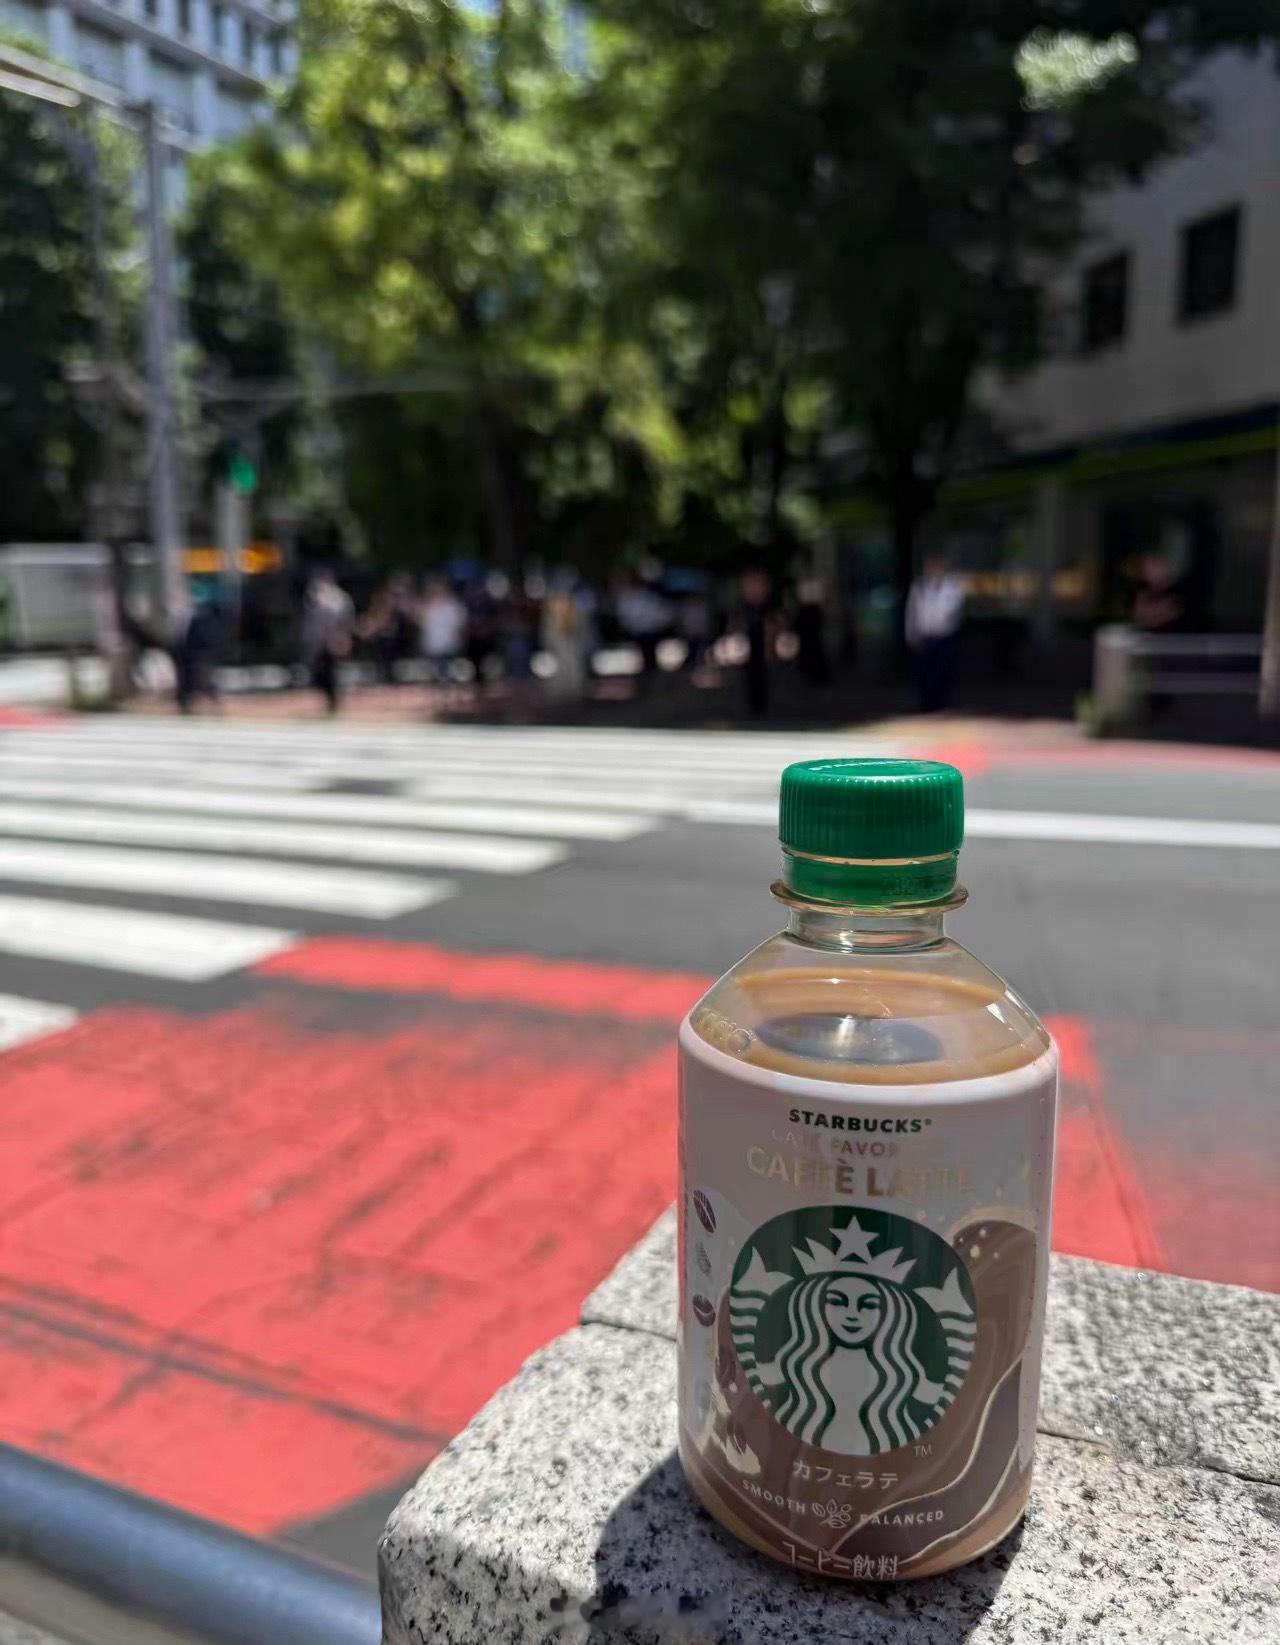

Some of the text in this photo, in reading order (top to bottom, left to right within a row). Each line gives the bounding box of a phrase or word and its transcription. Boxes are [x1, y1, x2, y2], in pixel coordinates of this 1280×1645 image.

[793, 1460, 898, 1490] カフェラテ
[742, 1480, 944, 1526] SMOOTH BALANCED
